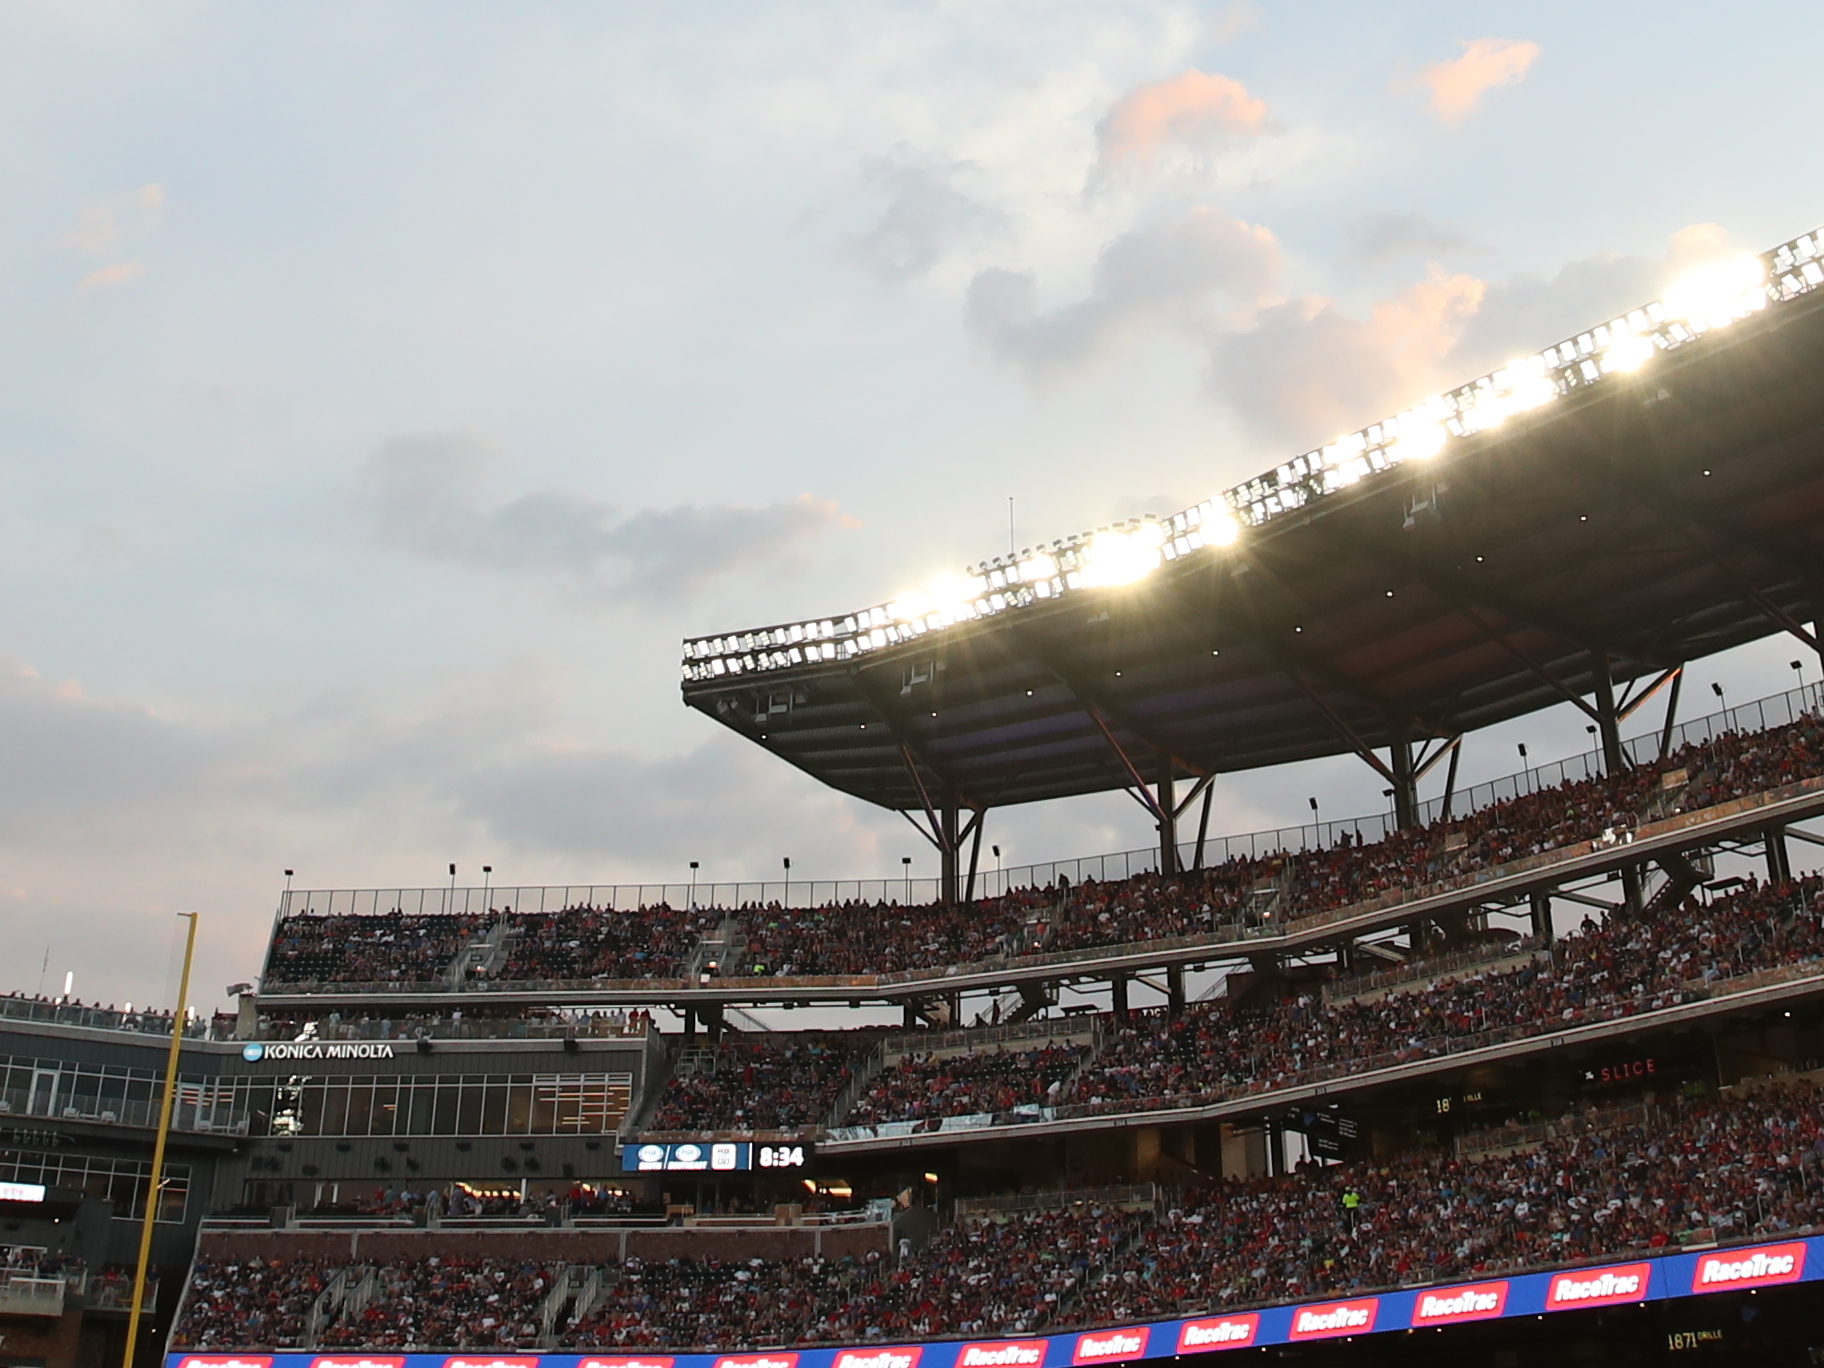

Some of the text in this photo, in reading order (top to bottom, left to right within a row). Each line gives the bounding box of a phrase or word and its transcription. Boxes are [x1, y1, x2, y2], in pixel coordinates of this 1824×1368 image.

[264, 1044, 395, 1060] KONICA MINOLTA
[1600, 1058, 1656, 1082] SLICE
[758, 1145, 805, 1168] 8:34
[1701, 1253, 1794, 1284] RaceTrac
[1554, 1272, 1641, 1302] RaceTrac
[1420, 1289, 1498, 1318] RaceTrac
[1297, 1306, 1369, 1332] RaceTrac
[1079, 1333, 1141, 1359] RaceTrac
[1183, 1321, 1251, 1347] RaceTrac
[1668, 1331, 1699, 1351] 1871
[963, 1345, 1040, 1367] RaceTrac
